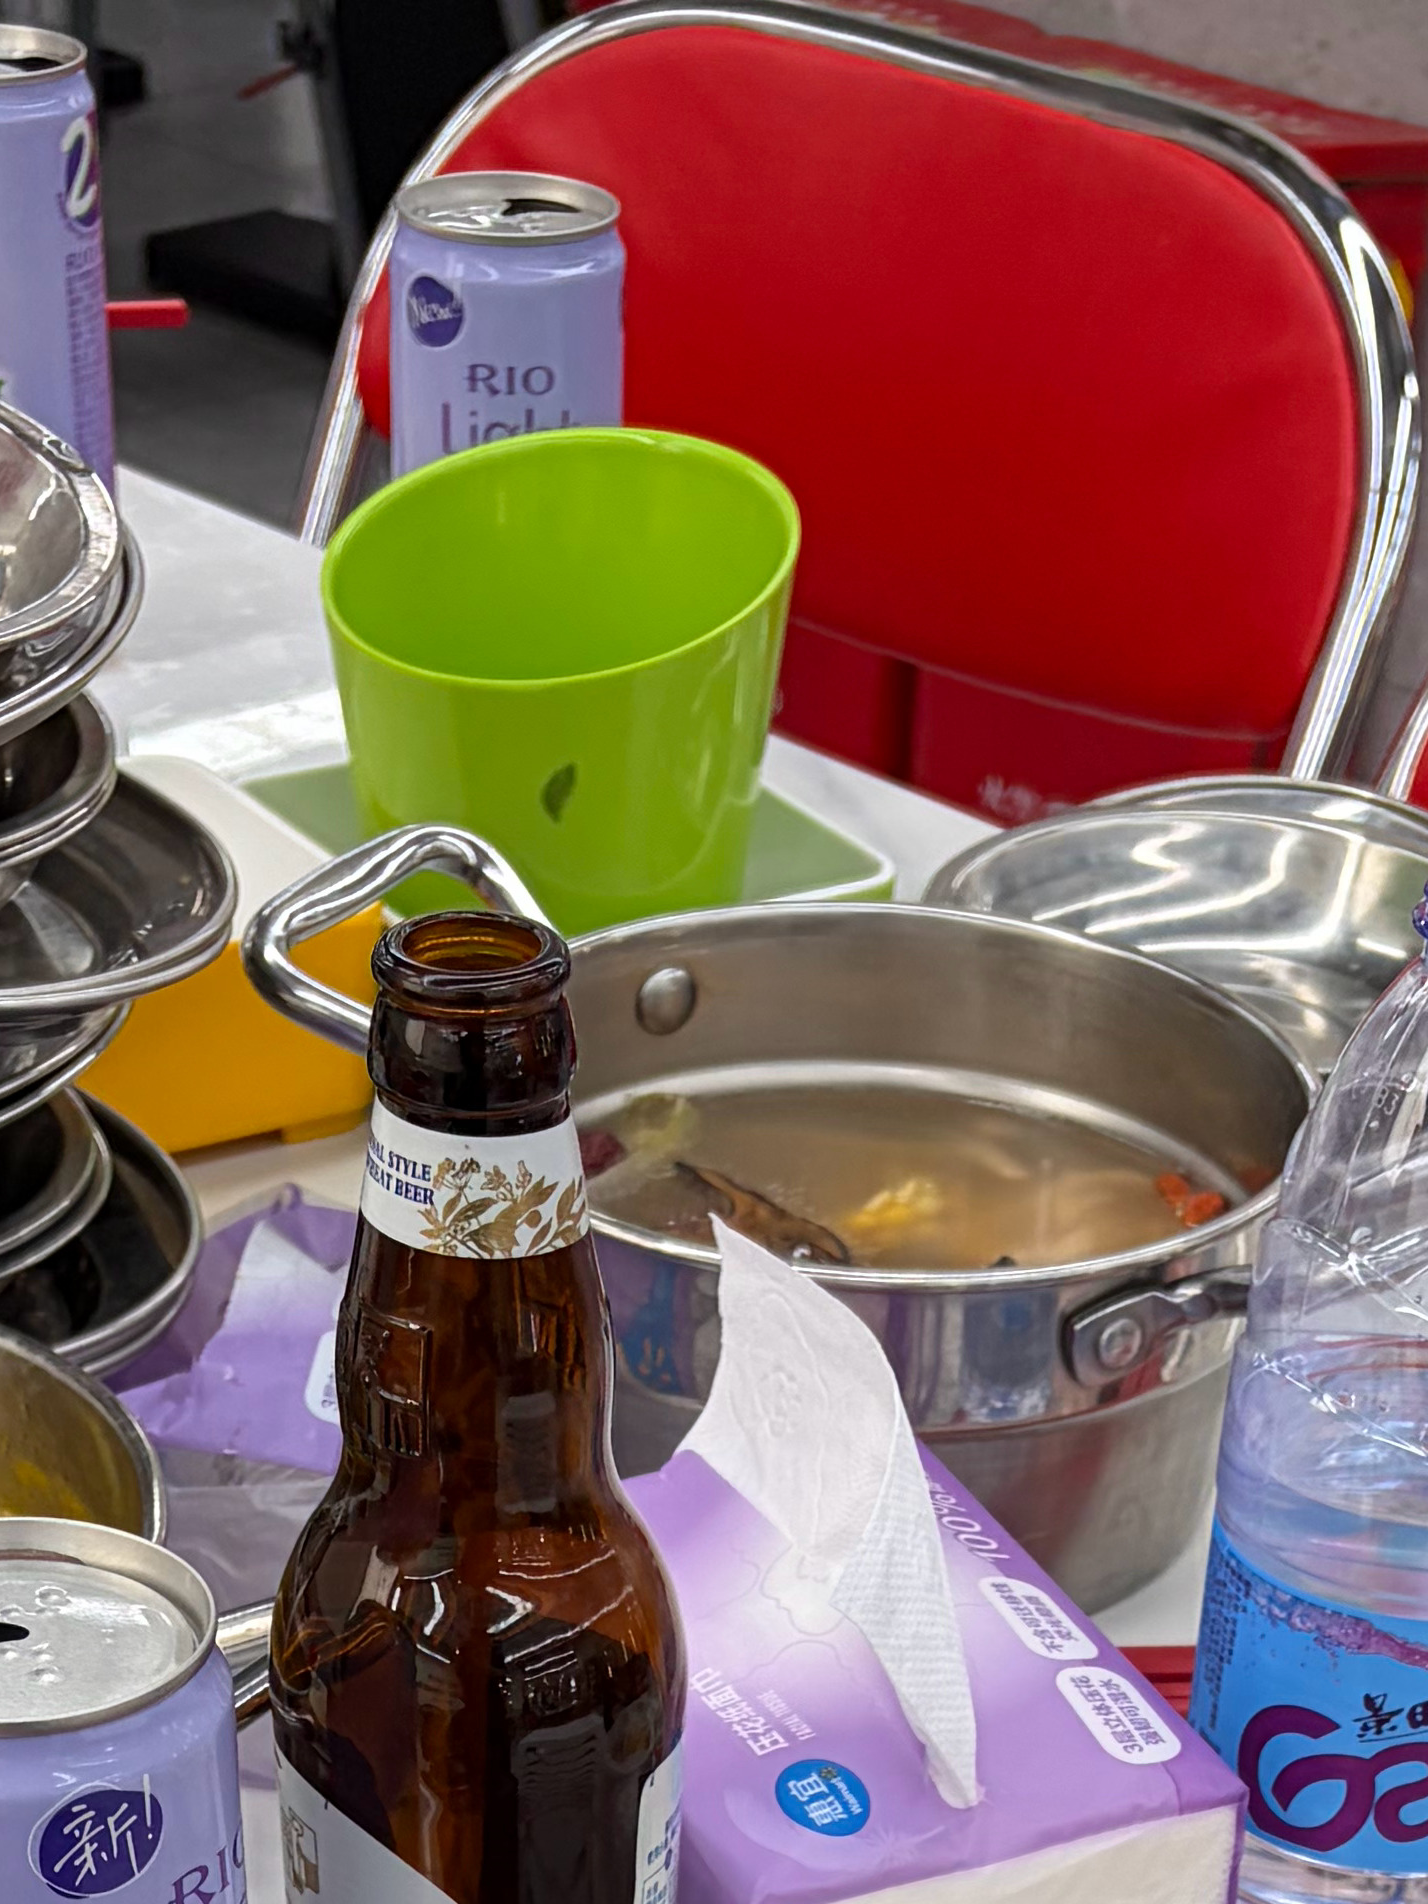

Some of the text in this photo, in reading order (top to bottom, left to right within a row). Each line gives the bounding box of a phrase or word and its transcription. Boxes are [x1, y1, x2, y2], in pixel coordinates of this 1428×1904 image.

[463, 363, 555, 397] RIO
[387, 1150, 432, 1182] STYLE
[395, 1177, 434, 1206] BEER
[931, 1490, 1010, 1562] 100%
[787, 1771, 849, 1828] 惠宜
[829, 1776, 863, 1816] Walmart
